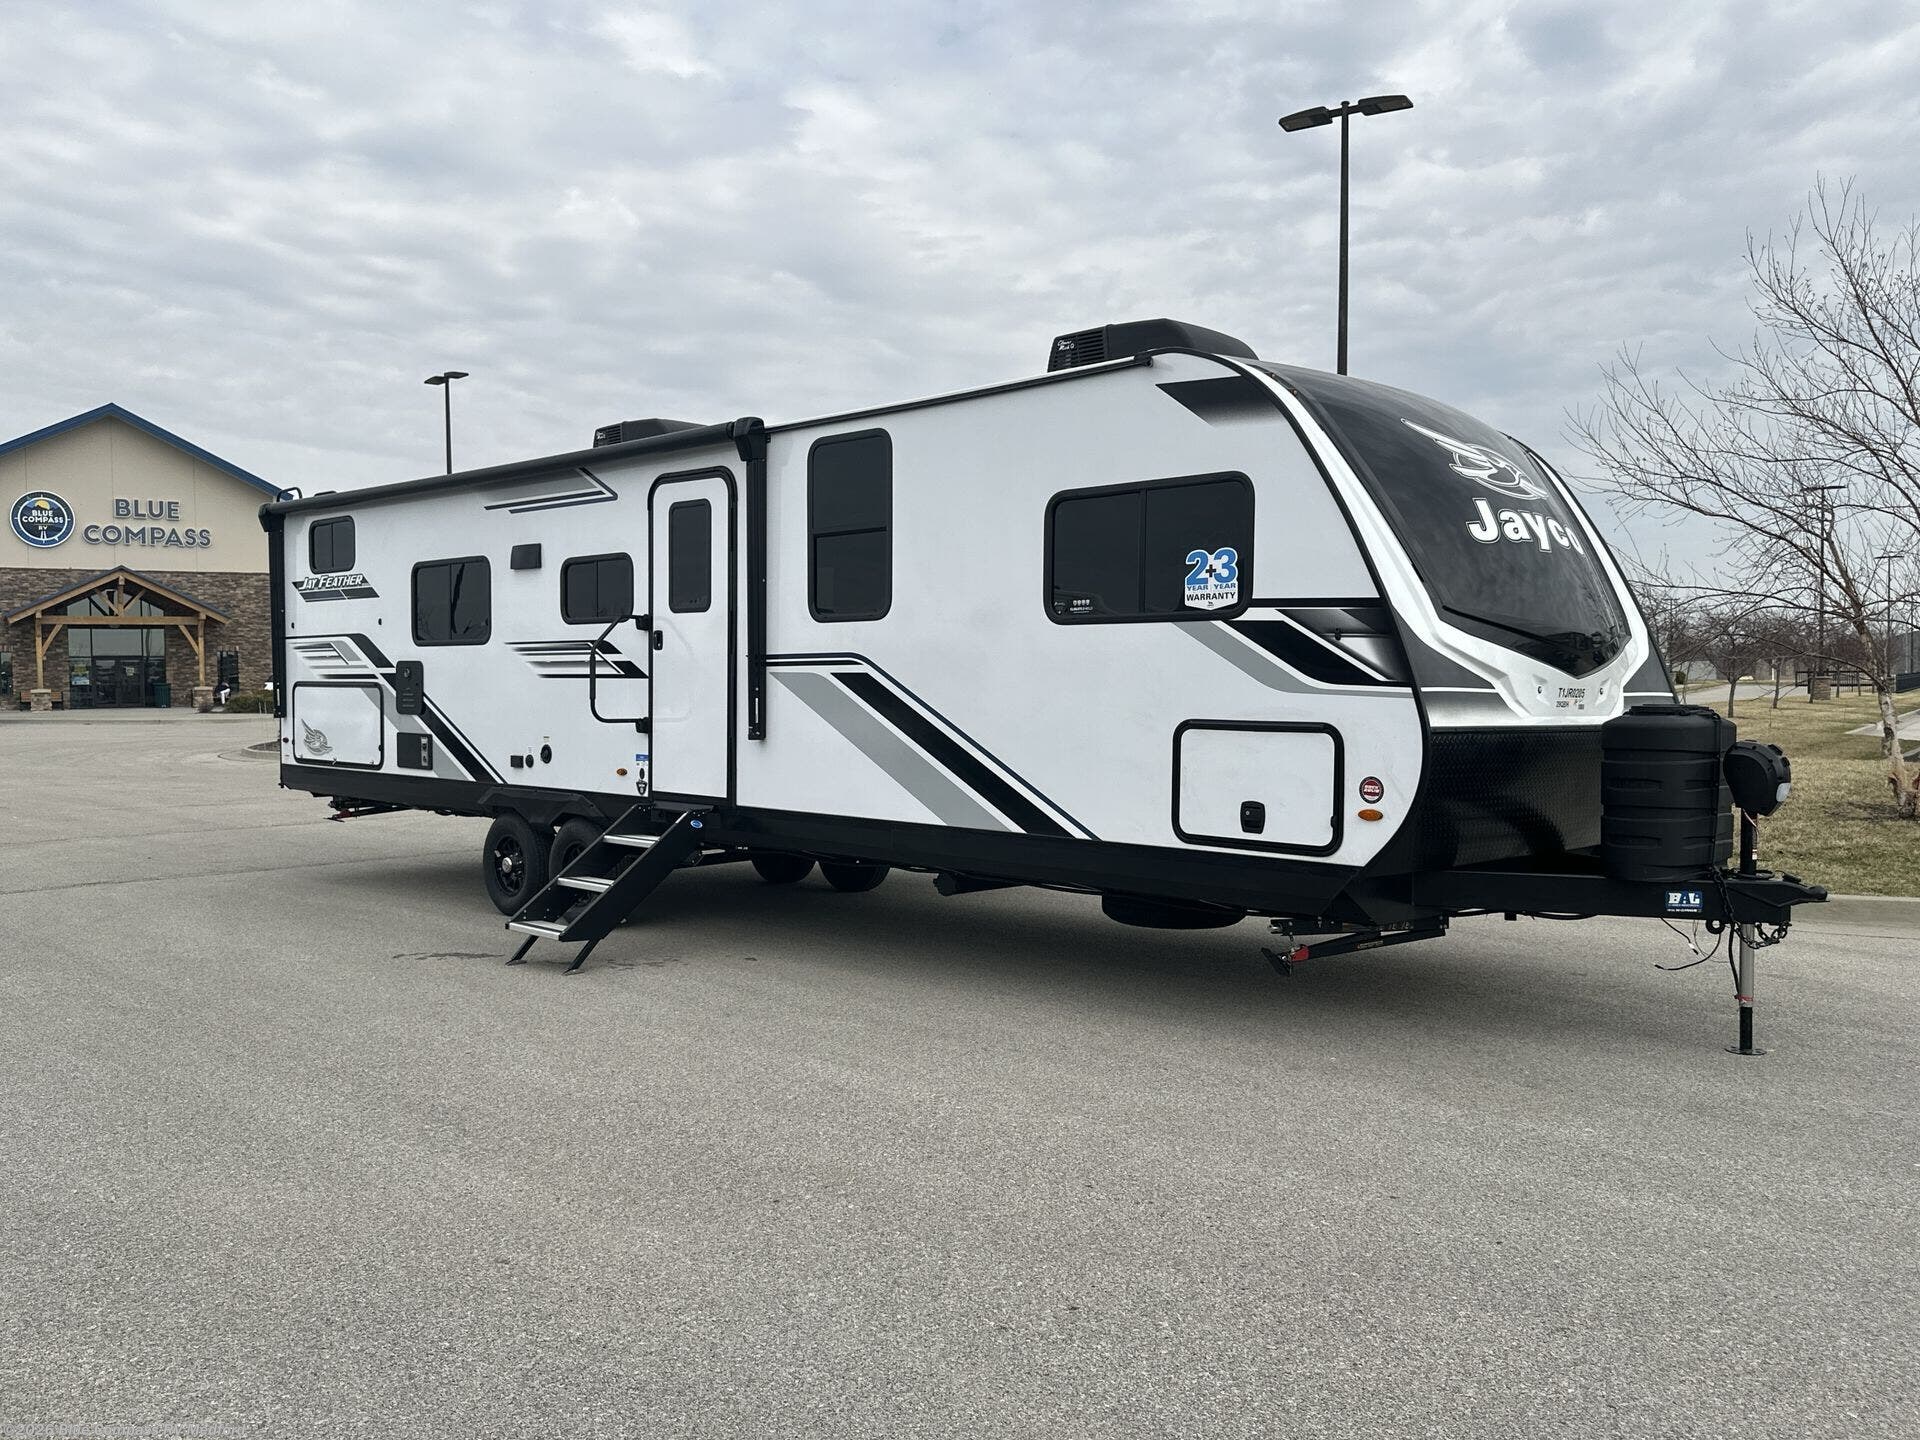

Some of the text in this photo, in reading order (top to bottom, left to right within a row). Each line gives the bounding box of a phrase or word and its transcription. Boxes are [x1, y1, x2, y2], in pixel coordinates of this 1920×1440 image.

[115, 498, 180, 521] BLUE
[83, 524, 212, 549] COMPASS
[1466, 498, 1585, 554] Jayco
[1186, 592, 1236, 601] WARRANTY
